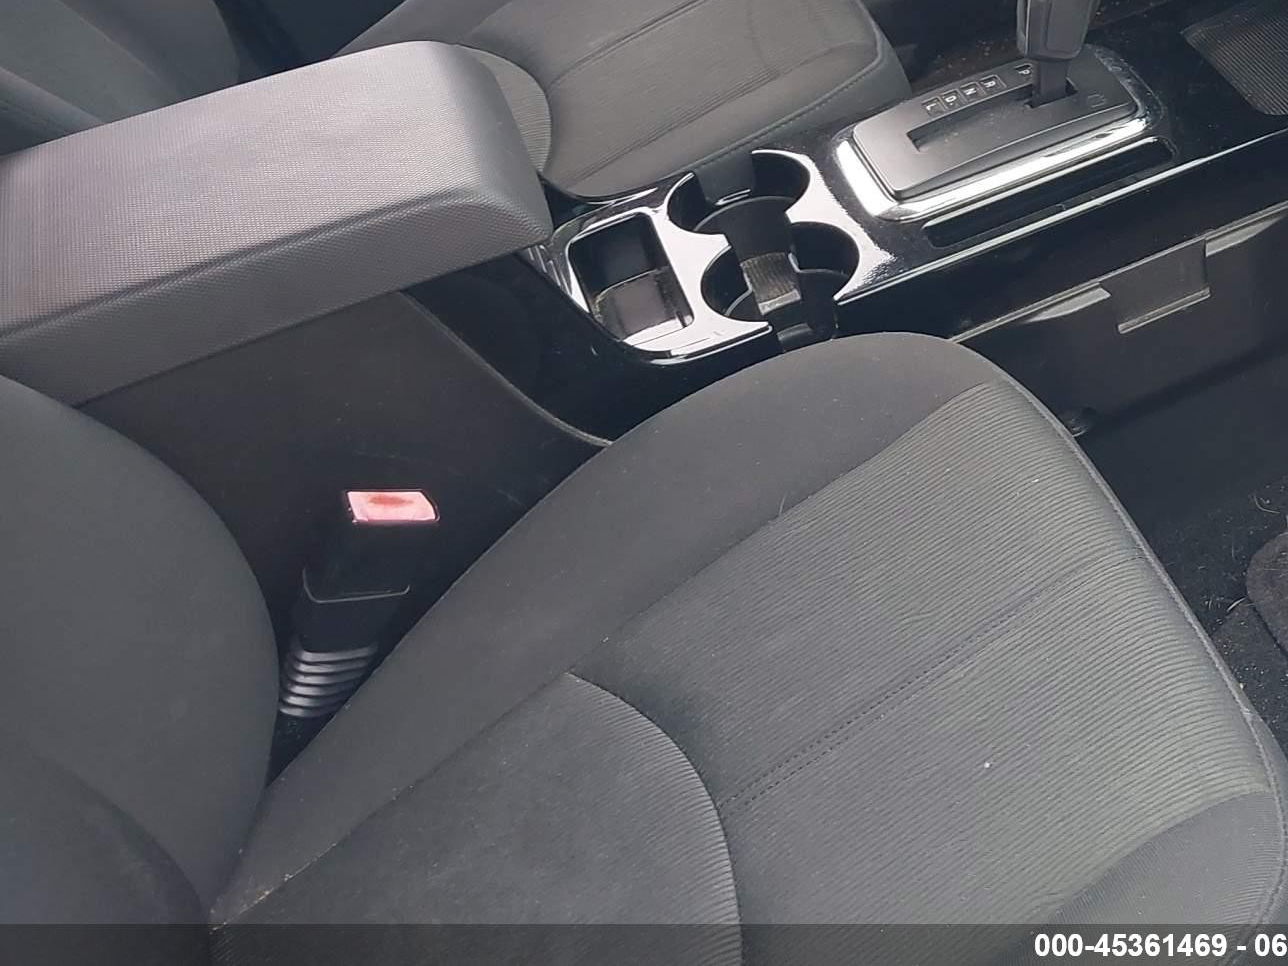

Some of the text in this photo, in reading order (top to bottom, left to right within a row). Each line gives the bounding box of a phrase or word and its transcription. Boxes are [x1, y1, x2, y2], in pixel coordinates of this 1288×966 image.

[983, 79, 997, 88] R
[963, 87, 977, 96] N
[925, 102, 937, 111] L
